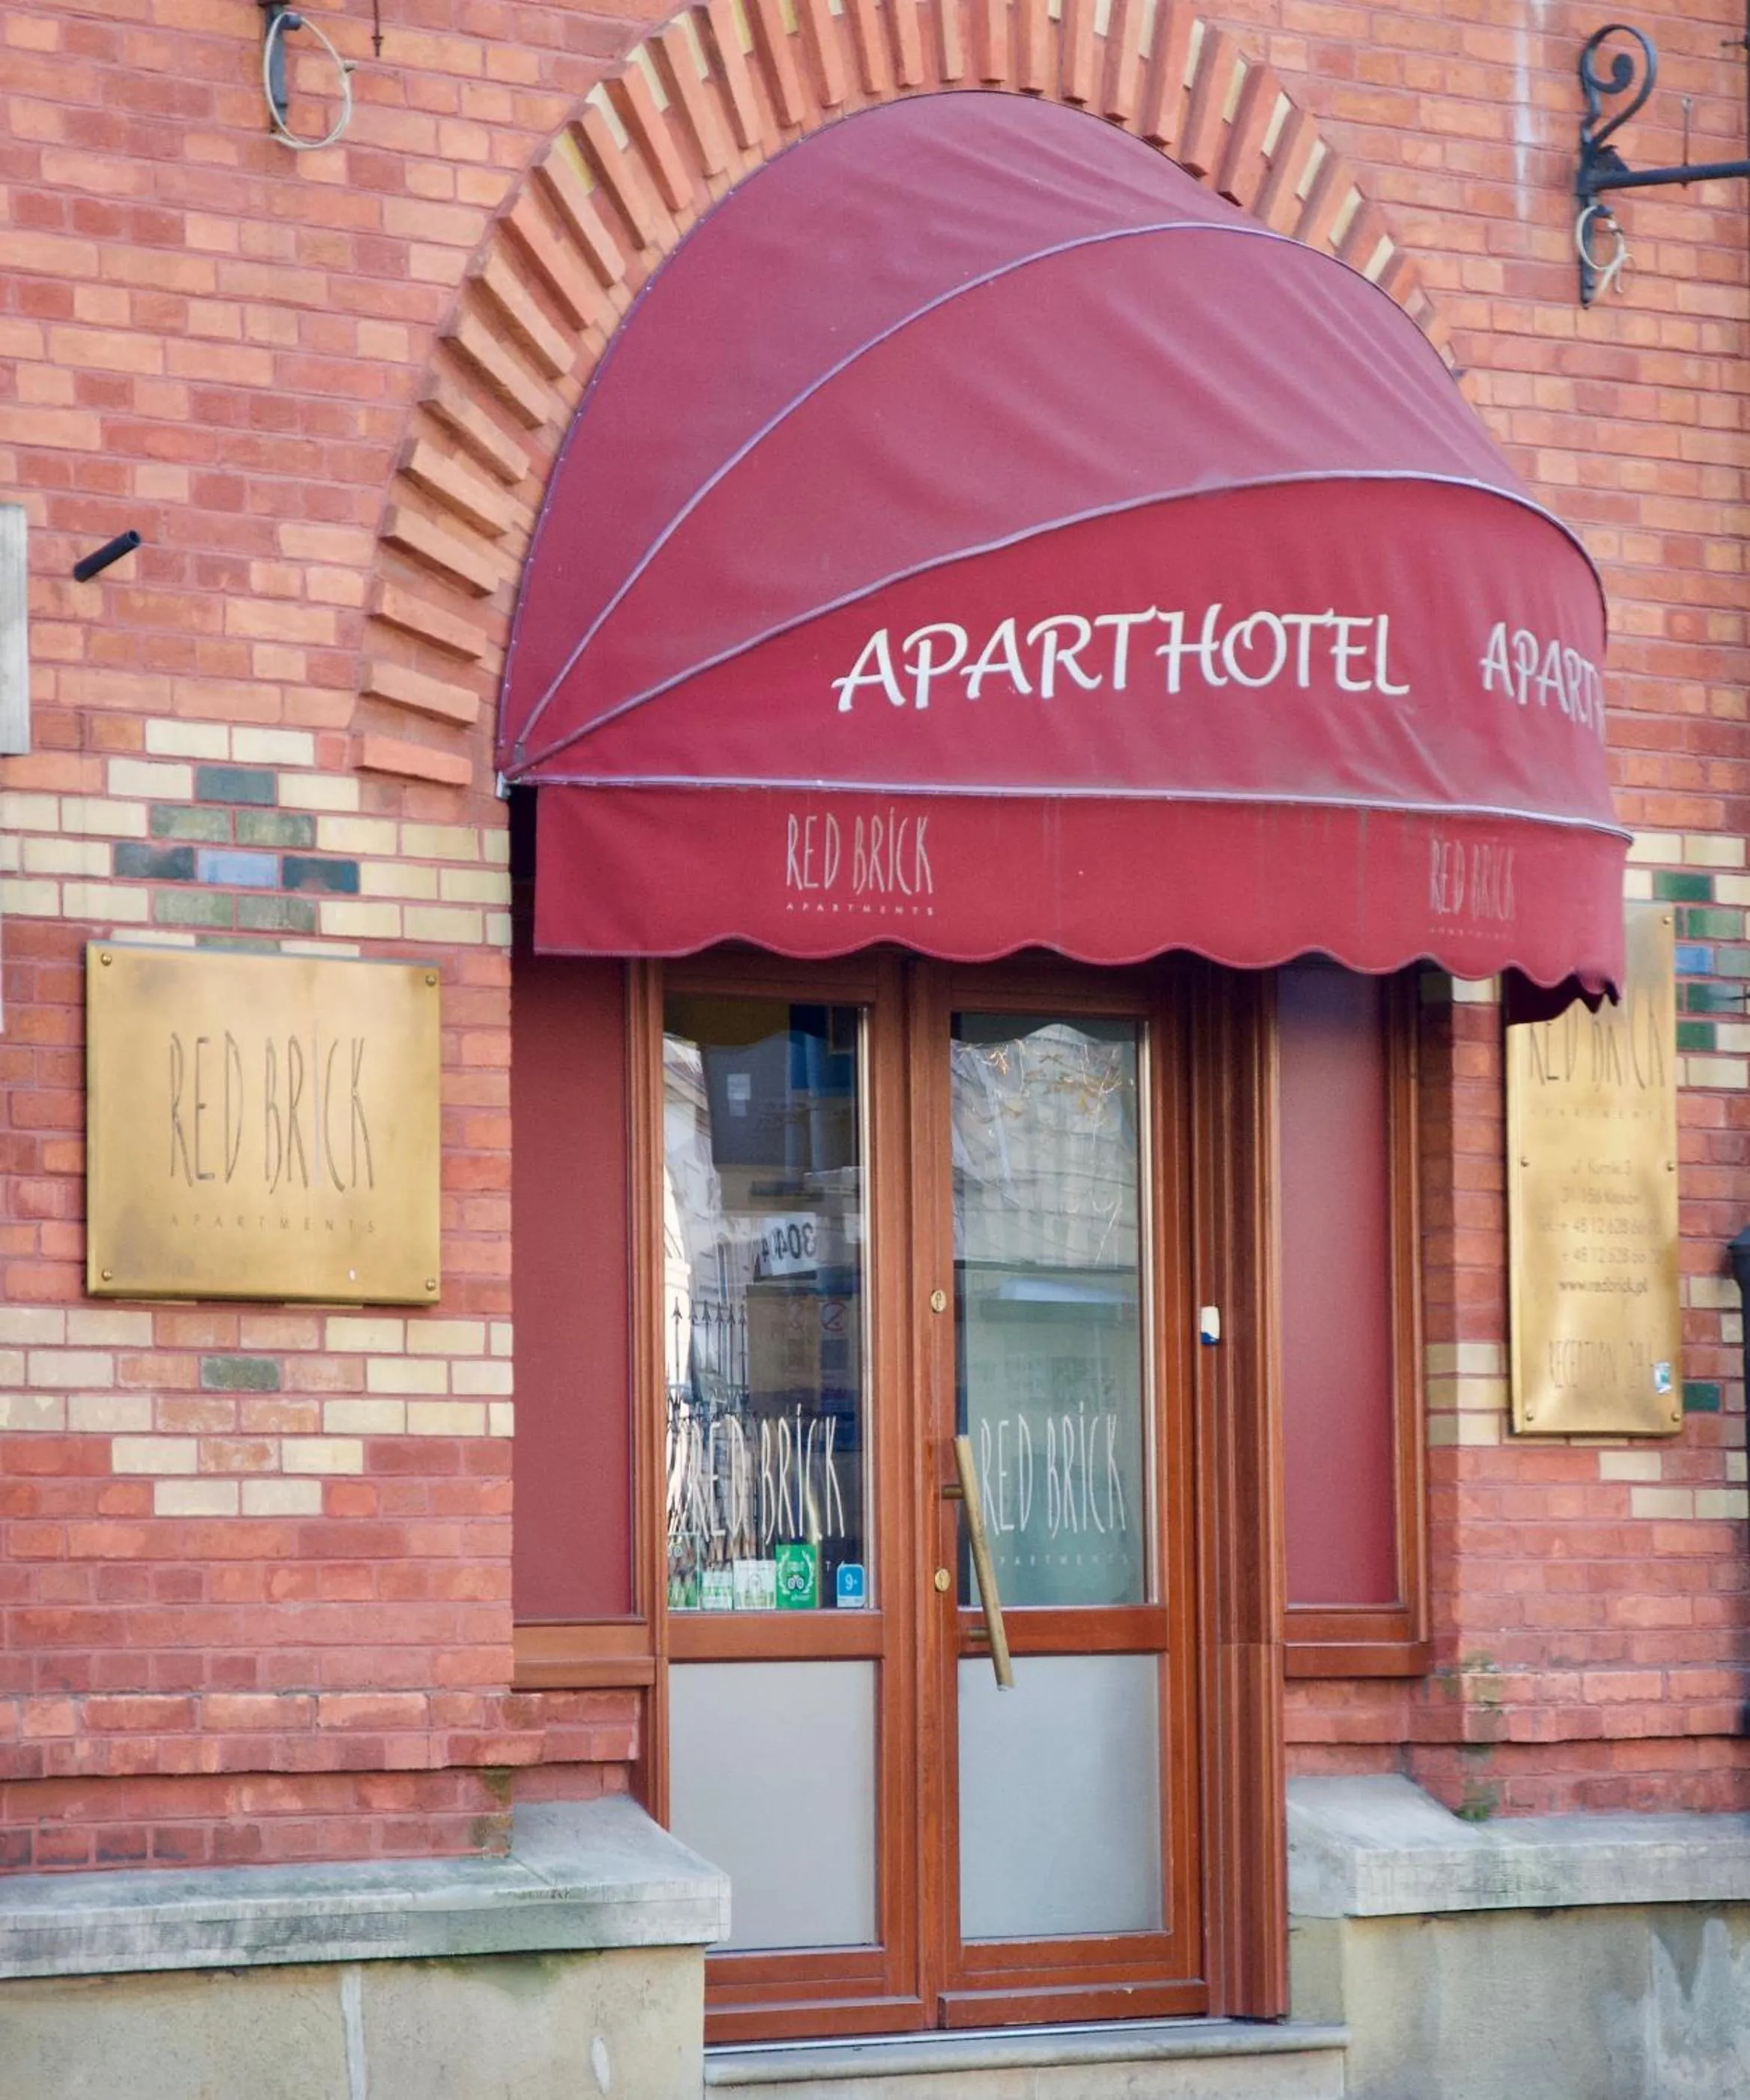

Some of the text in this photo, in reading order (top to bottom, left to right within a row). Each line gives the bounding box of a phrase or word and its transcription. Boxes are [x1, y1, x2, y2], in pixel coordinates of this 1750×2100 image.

[831, 603, 1410, 712] APARTHOTEL
[787, 813, 840, 891] RED
[169, 1029, 243, 1188] RED
[171, 1213, 375, 1233] APARTMENTS
[981, 1413, 1033, 1536] RED
